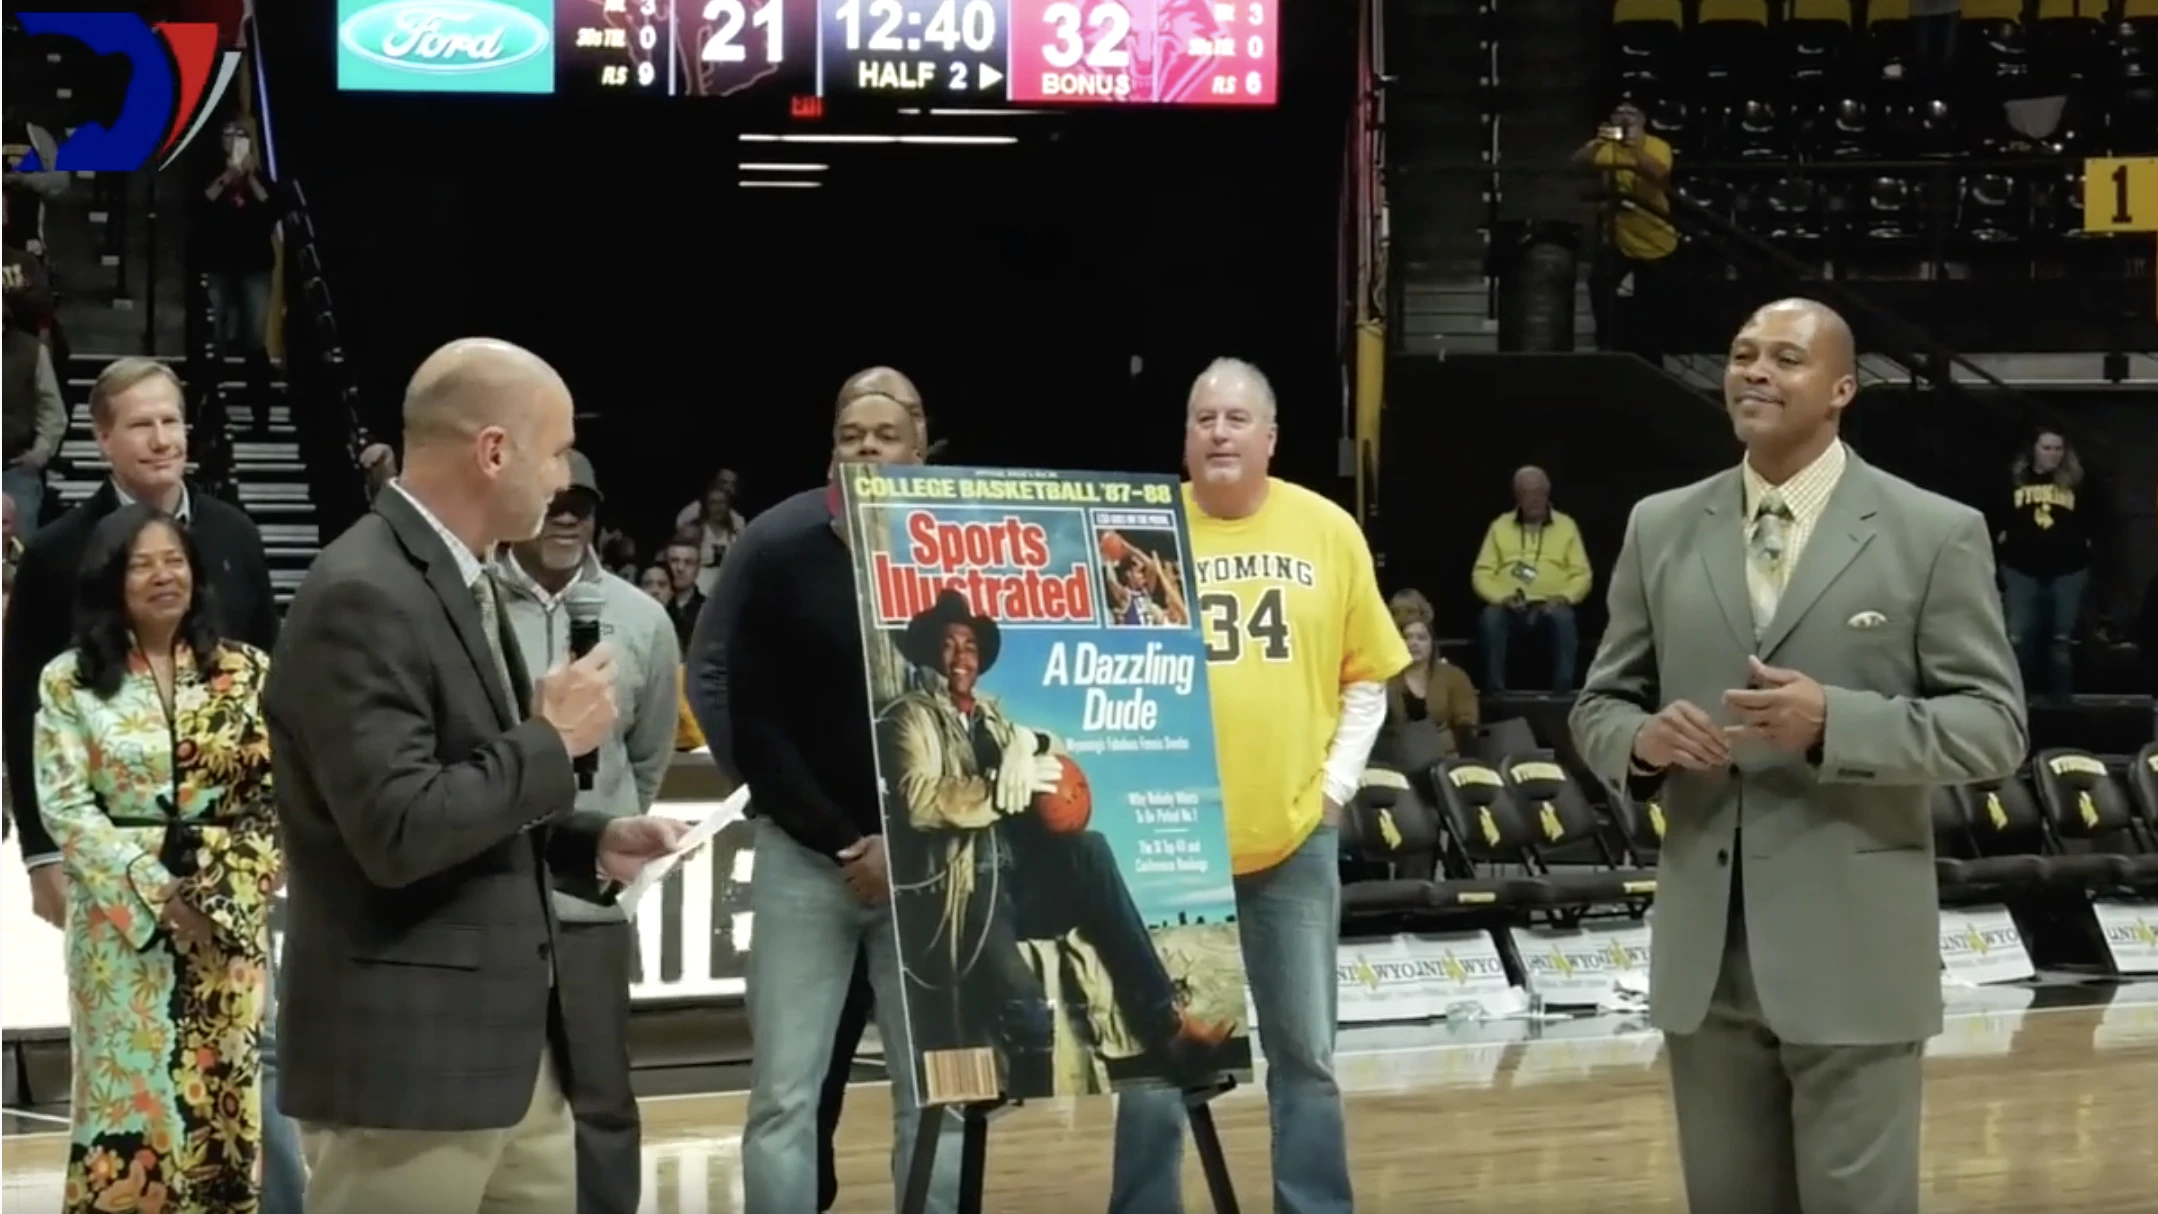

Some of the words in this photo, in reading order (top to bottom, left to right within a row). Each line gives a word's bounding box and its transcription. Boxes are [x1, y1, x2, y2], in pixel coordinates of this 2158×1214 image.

[702, 0, 783, 62] 21
[836, 0, 996, 51] 12:40
[1248, 3, 1263, 25] 3
[383, 8, 505, 59] Ford
[640, 25, 656, 48] 0
[1041, 2, 1130, 67] 32
[1248, 36, 1263, 58] 0
[638, 62, 654, 85] 9
[859, 60, 936, 88] HALF
[948, 61, 967, 89] 2
[1042, 72, 1130, 95] BONUS
[1246, 71, 1262, 95] 6
[2111, 164, 2133, 224] 1
[854, 477, 957, 500] COLLEGE
[959, 479, 1099, 502] BASKETBALL
[906, 509, 1050, 570] Sports
[1196, 554, 1314, 587] YOMING
[1199, 588, 1289, 662] 34
[1042, 641, 1069, 686] A
[1074, 641, 1195, 695] Dazzling
[1082, 687, 1158, 731] Dude
